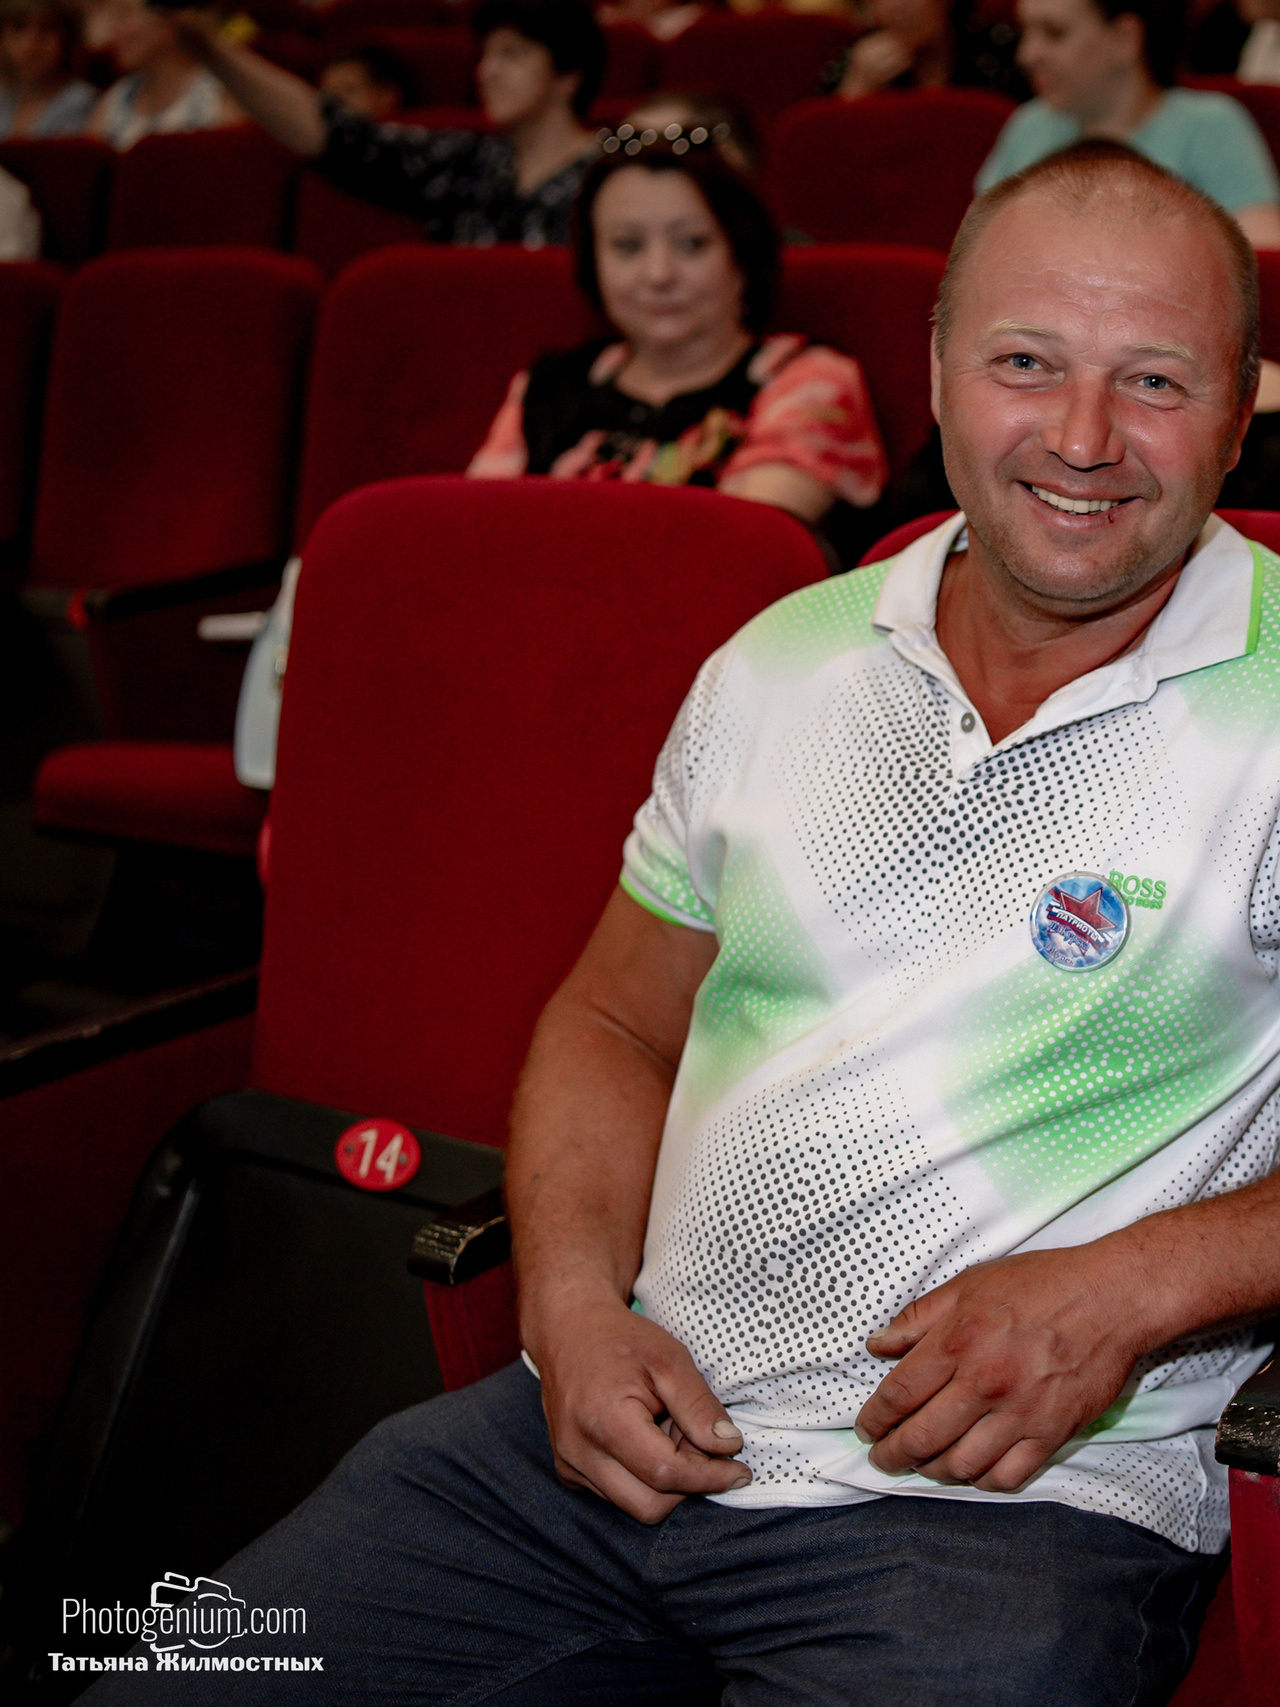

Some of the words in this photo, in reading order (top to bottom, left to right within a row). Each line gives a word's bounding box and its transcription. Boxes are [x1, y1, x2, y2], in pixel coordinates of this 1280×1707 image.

[1109, 871, 1167, 899] BOSS
[1056, 911, 1099, 942] ПАТРИОТЫ
[359, 1128, 404, 1184] 14
